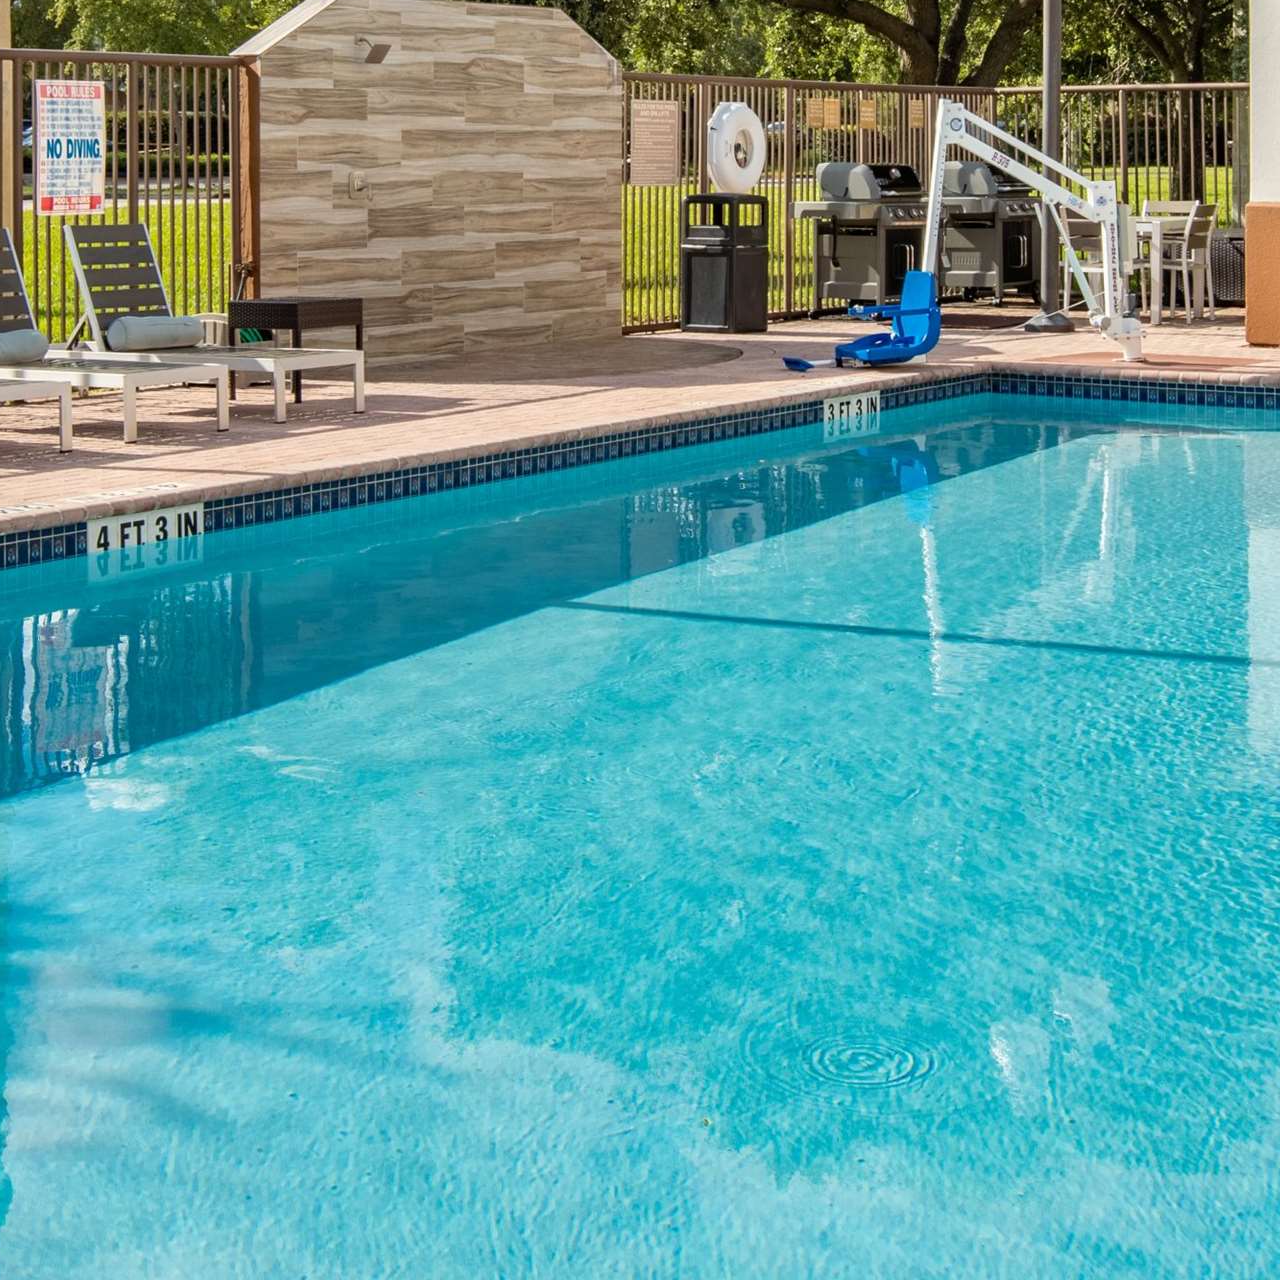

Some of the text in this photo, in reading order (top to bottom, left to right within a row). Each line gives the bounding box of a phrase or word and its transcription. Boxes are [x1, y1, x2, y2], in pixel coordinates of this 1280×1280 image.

[46, 85, 69, 97] POOL
[46, 138, 62, 158] NO
[827, 403, 835, 421] 3
[855, 399, 863, 416] 3
[96, 525, 110, 551] 4
[155, 515, 169, 541] 3
